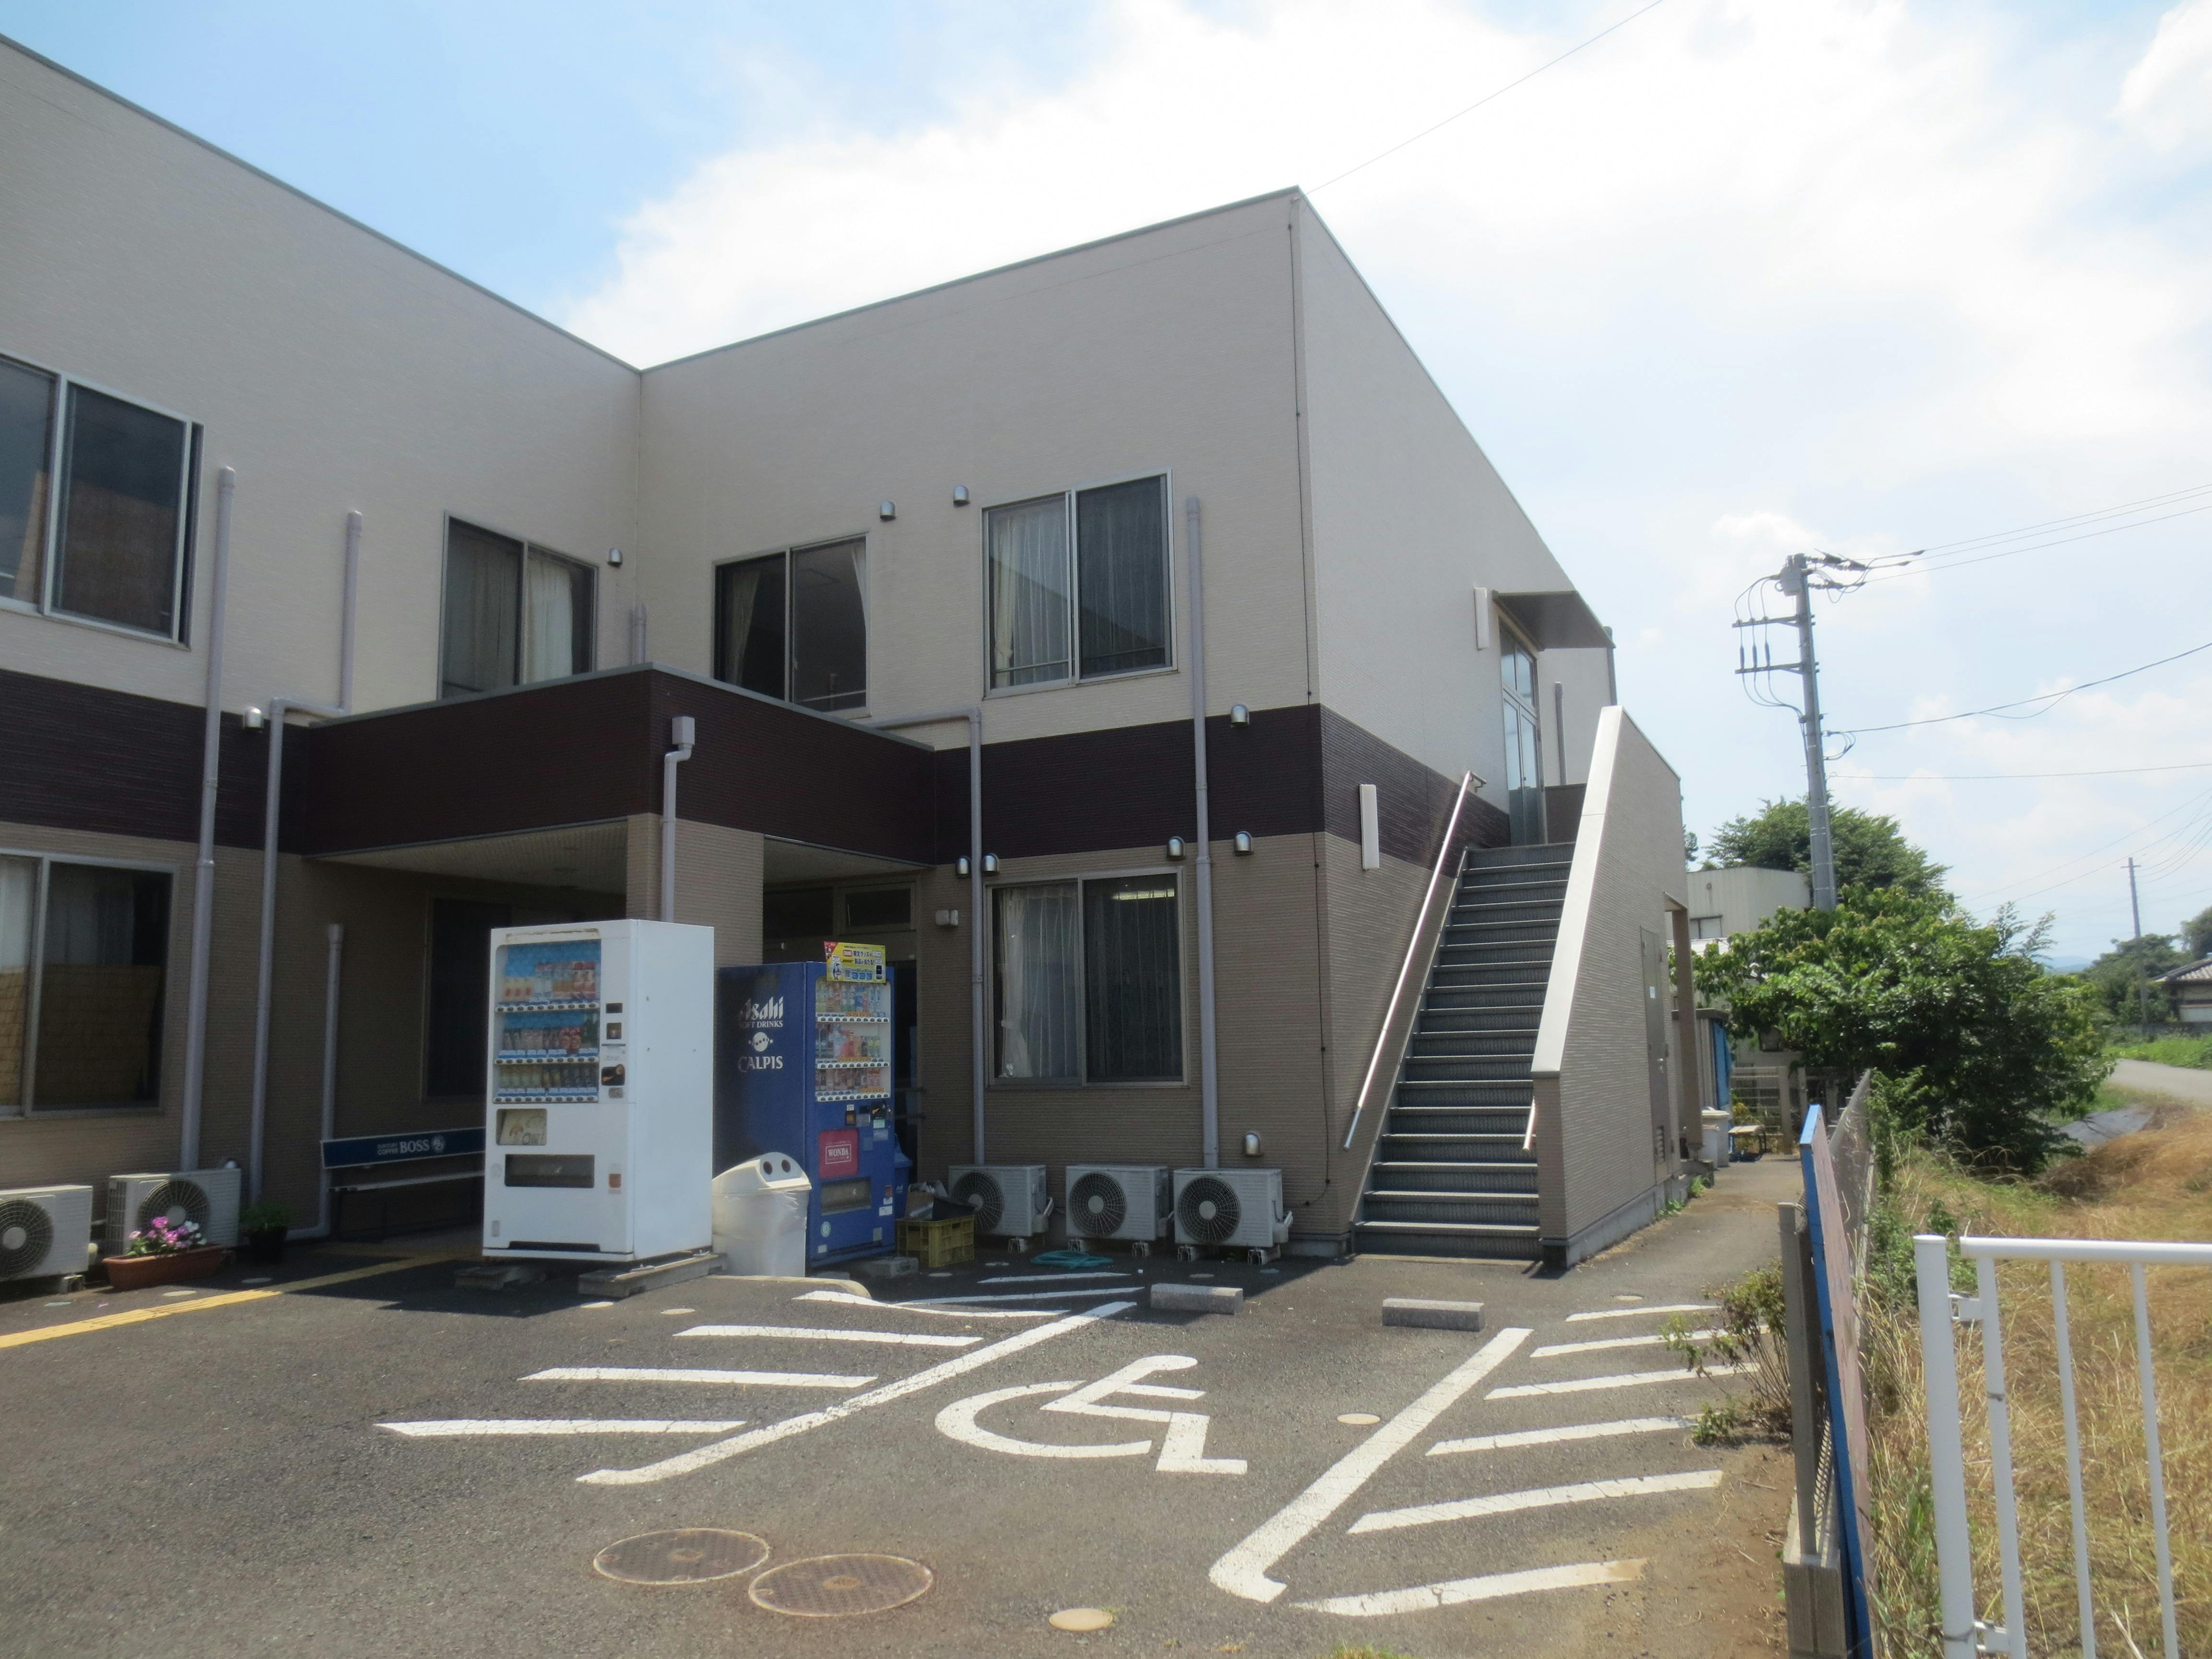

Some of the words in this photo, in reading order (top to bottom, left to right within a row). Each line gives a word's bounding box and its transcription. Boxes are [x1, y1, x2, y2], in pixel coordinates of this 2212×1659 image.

[739, 996, 783, 1020] Asahi
[757, 1020, 783, 1028] DRINKS
[738, 1056, 783, 1072] CALPIS
[399, 1140, 430, 1154] BOSS
[828, 1148, 849, 1157] WONDA
